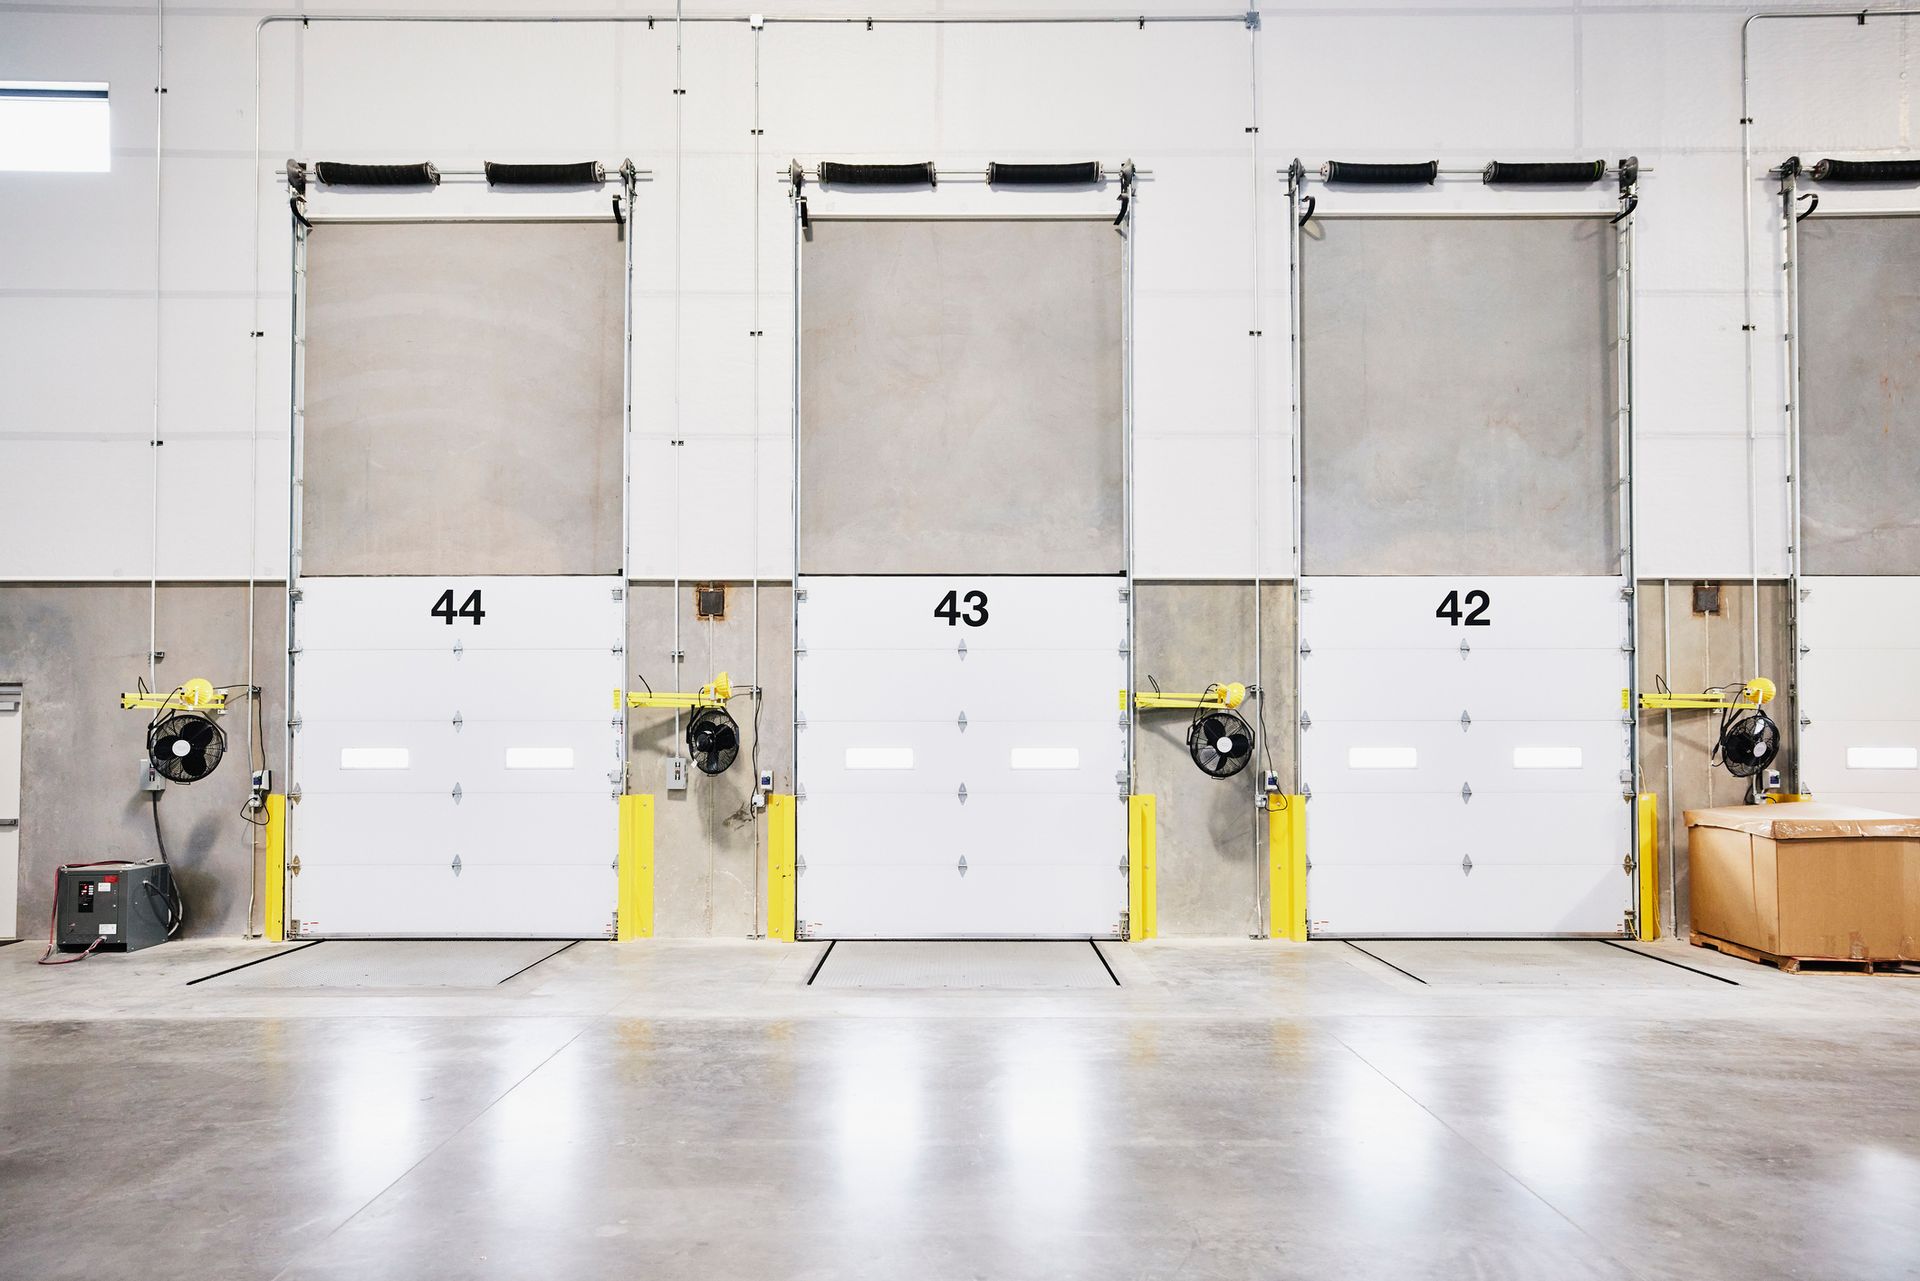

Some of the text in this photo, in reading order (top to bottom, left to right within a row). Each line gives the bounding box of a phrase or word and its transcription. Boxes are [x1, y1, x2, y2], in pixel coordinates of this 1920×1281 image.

[431, 589, 486, 626] 44
[934, 590, 989, 627] 43
[1436, 590, 1491, 626] 42
